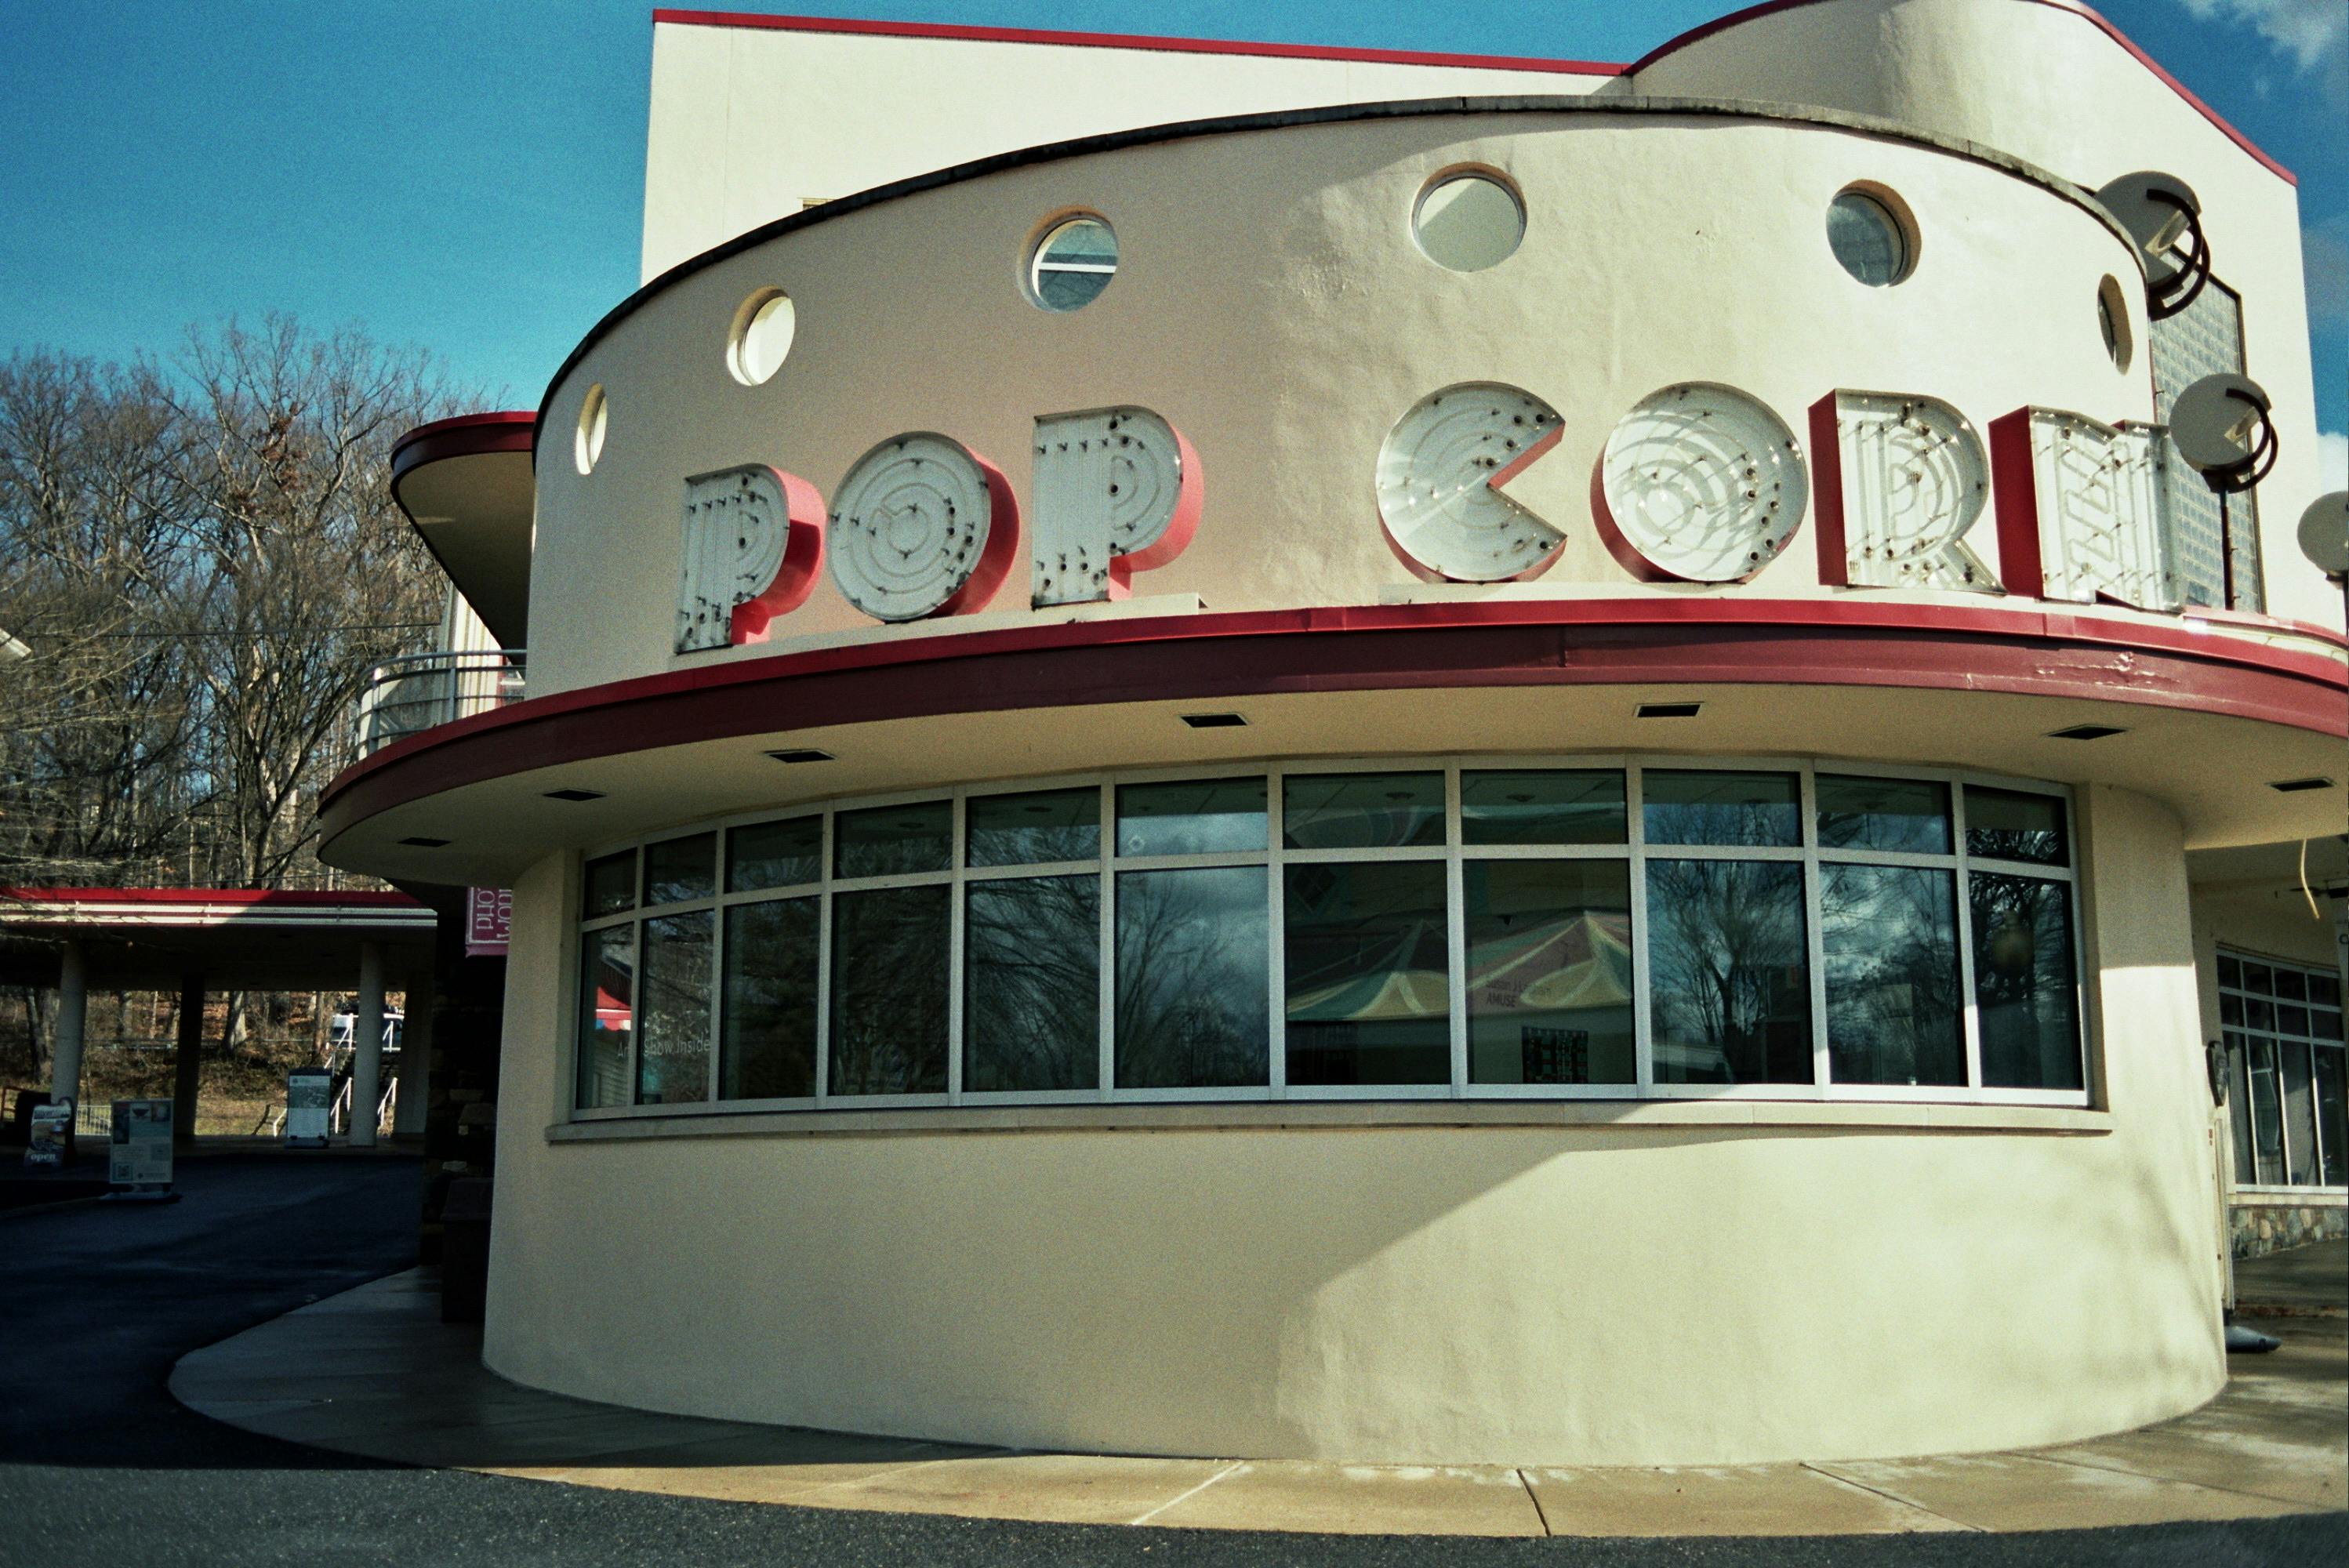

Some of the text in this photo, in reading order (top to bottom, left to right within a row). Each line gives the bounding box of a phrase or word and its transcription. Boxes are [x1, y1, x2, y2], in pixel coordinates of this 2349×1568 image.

[674, 380, 2186, 654] POP CORN
[477, 887, 495, 930] PHO
[1486, 992, 1517, 1008] AMUSE
